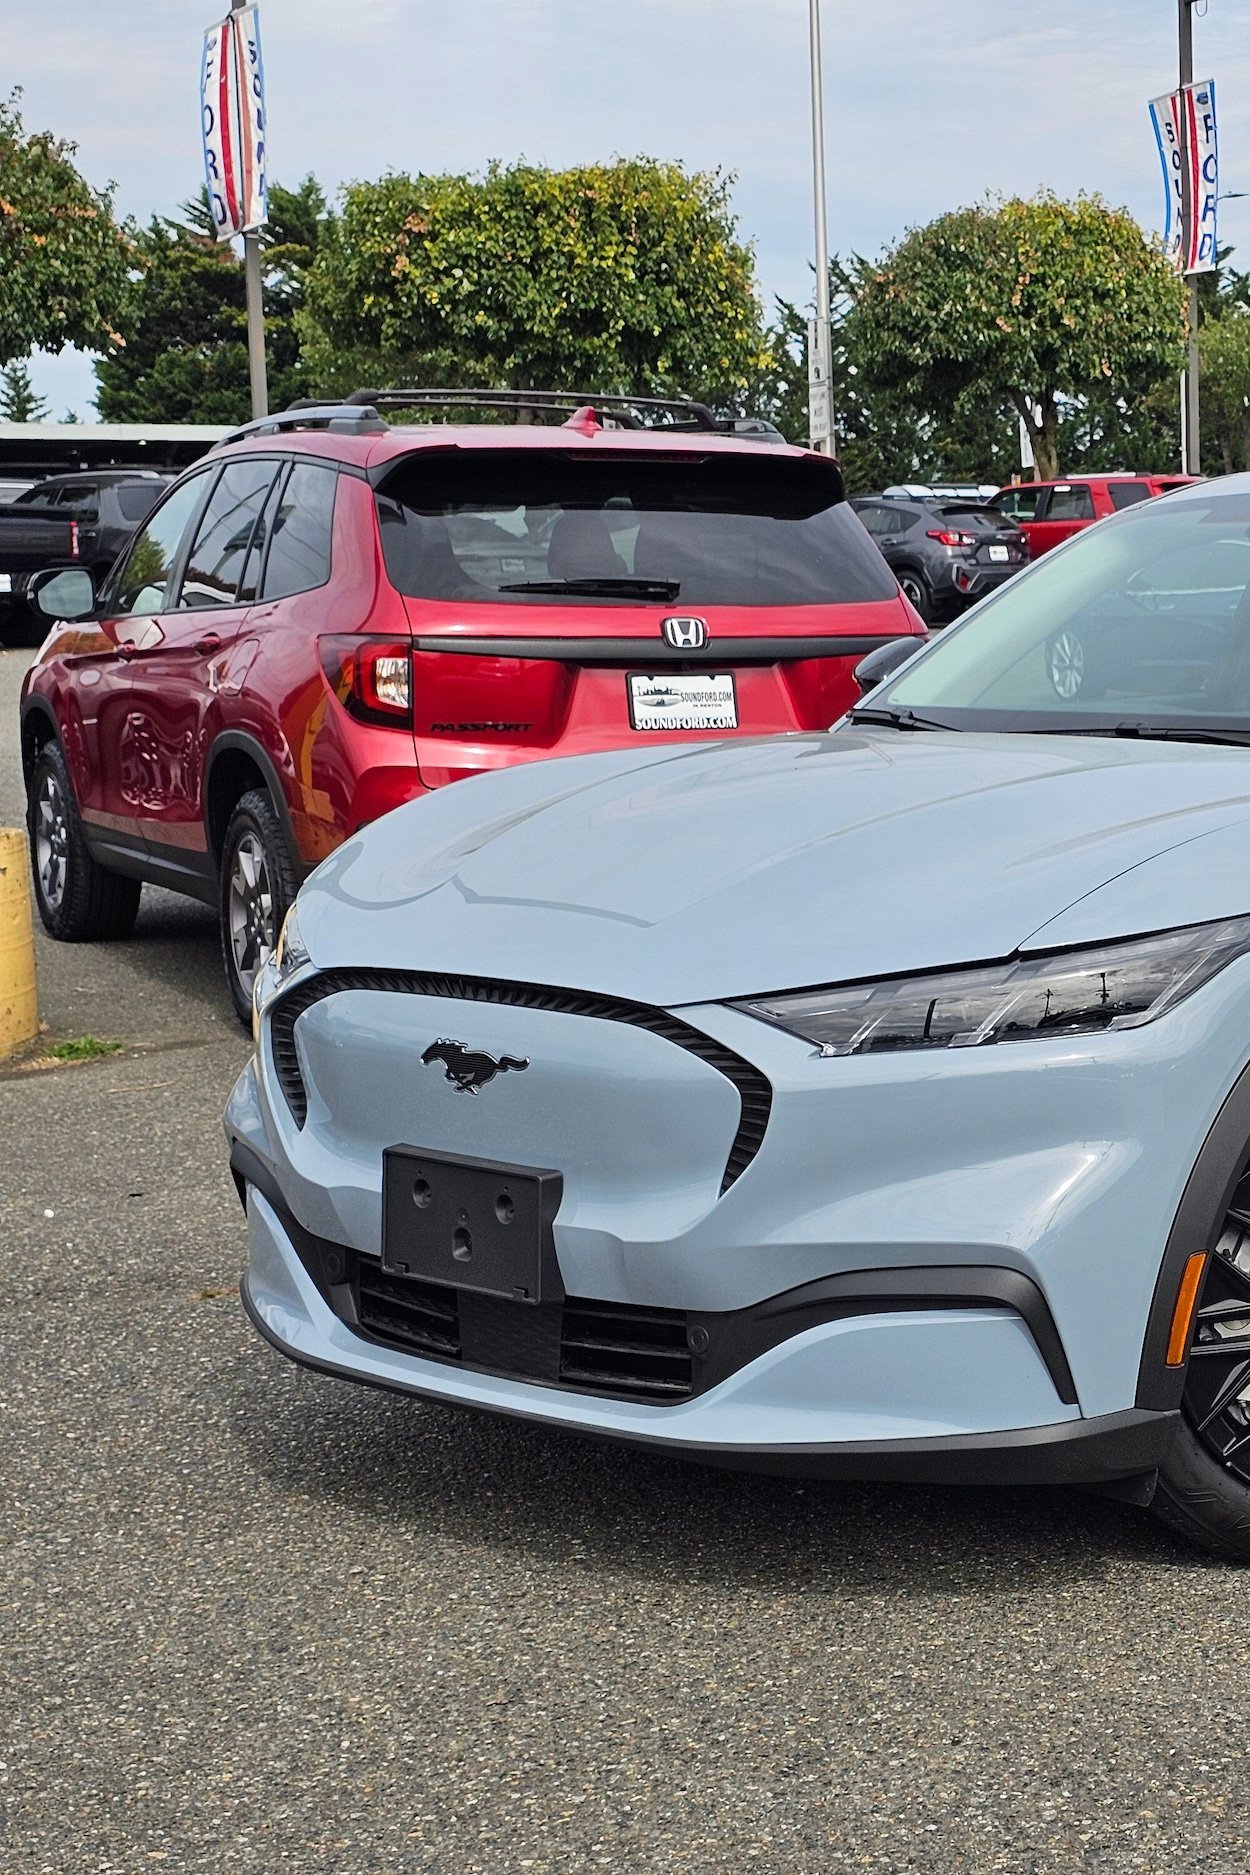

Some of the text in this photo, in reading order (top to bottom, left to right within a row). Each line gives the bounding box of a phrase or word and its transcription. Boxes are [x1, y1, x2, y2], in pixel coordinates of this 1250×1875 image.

[1199, 114, 1218, 260] FORD
[681, 692, 732, 703] SOUNDFORD.COM
[431, 722, 534, 733] PASSPORT
[635, 717, 737, 730] SOUNDFORD.COM
